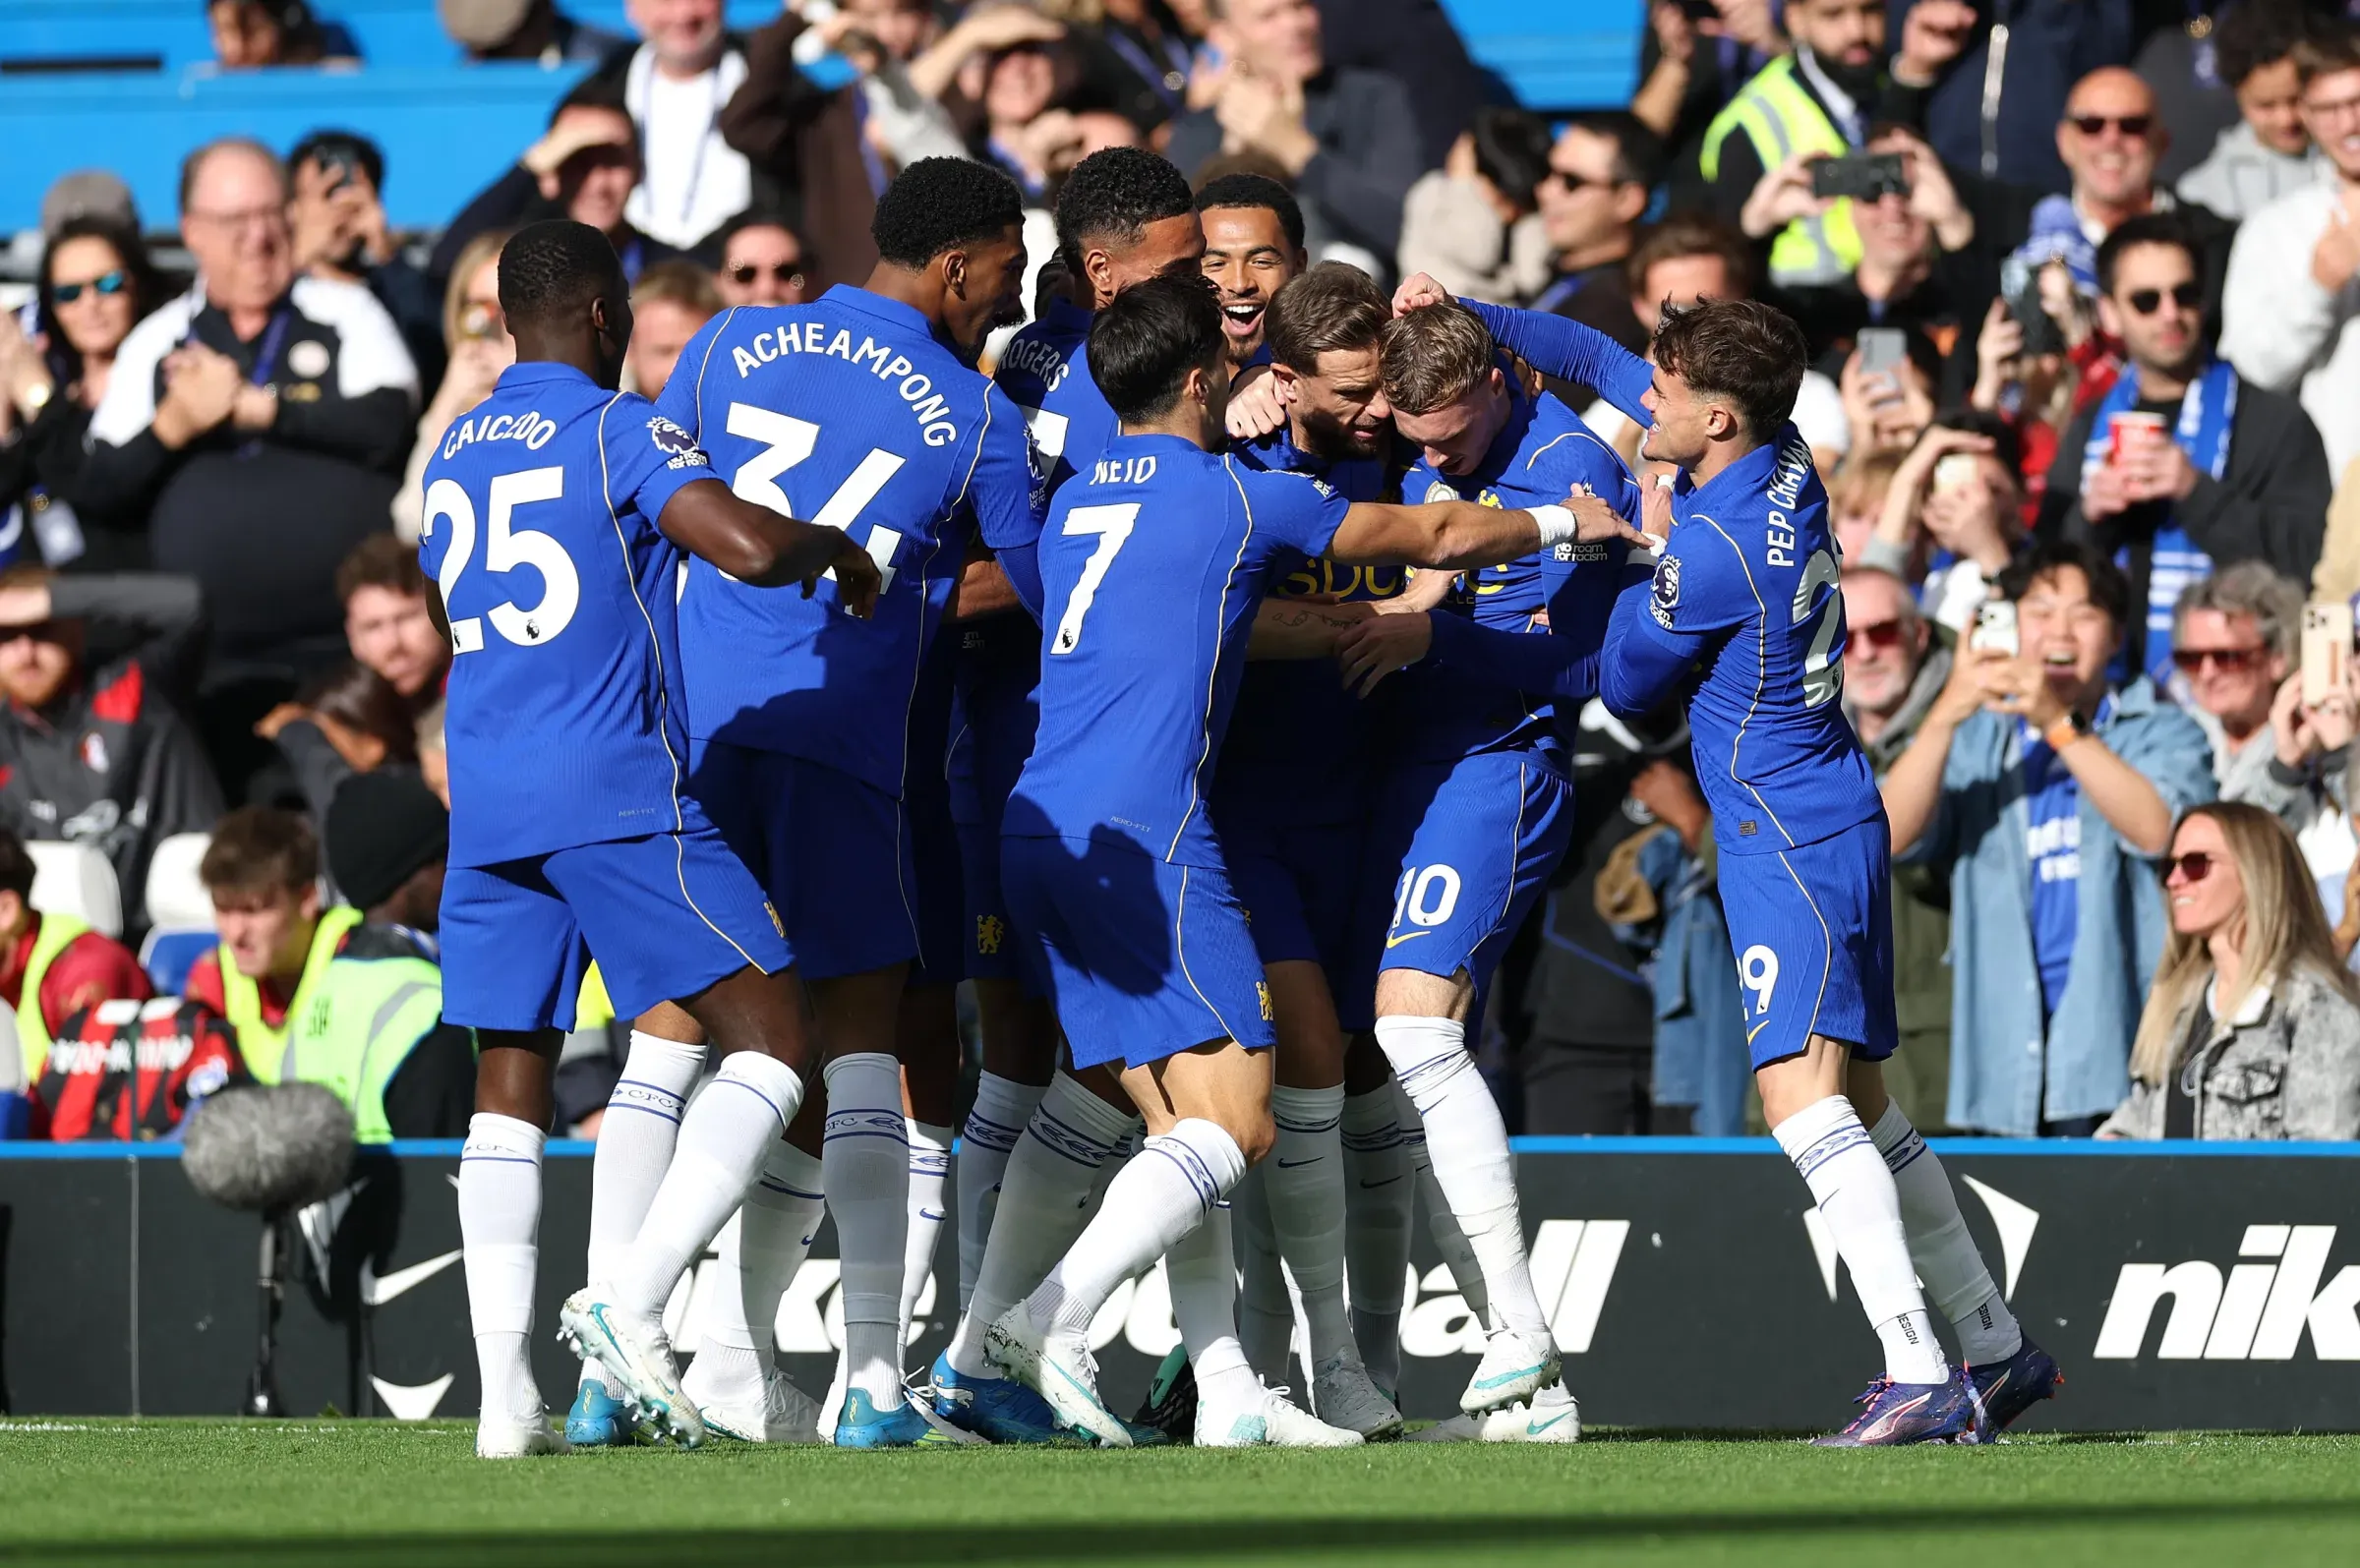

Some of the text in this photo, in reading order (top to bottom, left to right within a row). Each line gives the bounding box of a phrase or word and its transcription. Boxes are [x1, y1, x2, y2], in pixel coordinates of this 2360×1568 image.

[732, 322, 958, 447] ACHEAMPONG
[442, 410, 557, 461] CAICEDO
[423, 465, 580, 657] 25
[1571, 552, 1608, 561] racism
[1573, 544, 1603, 552] room
[1766, 510, 1796, 567] PEP
[1049, 502, 1144, 655] 7
[1793, 539, 1844, 709] 2
[1392, 864, 1461, 928] 10
[1737, 945, 1779, 1021] 9
[628, 1089, 674, 1108] CFC
[1977, 1303, 1994, 1330] ESIGN
